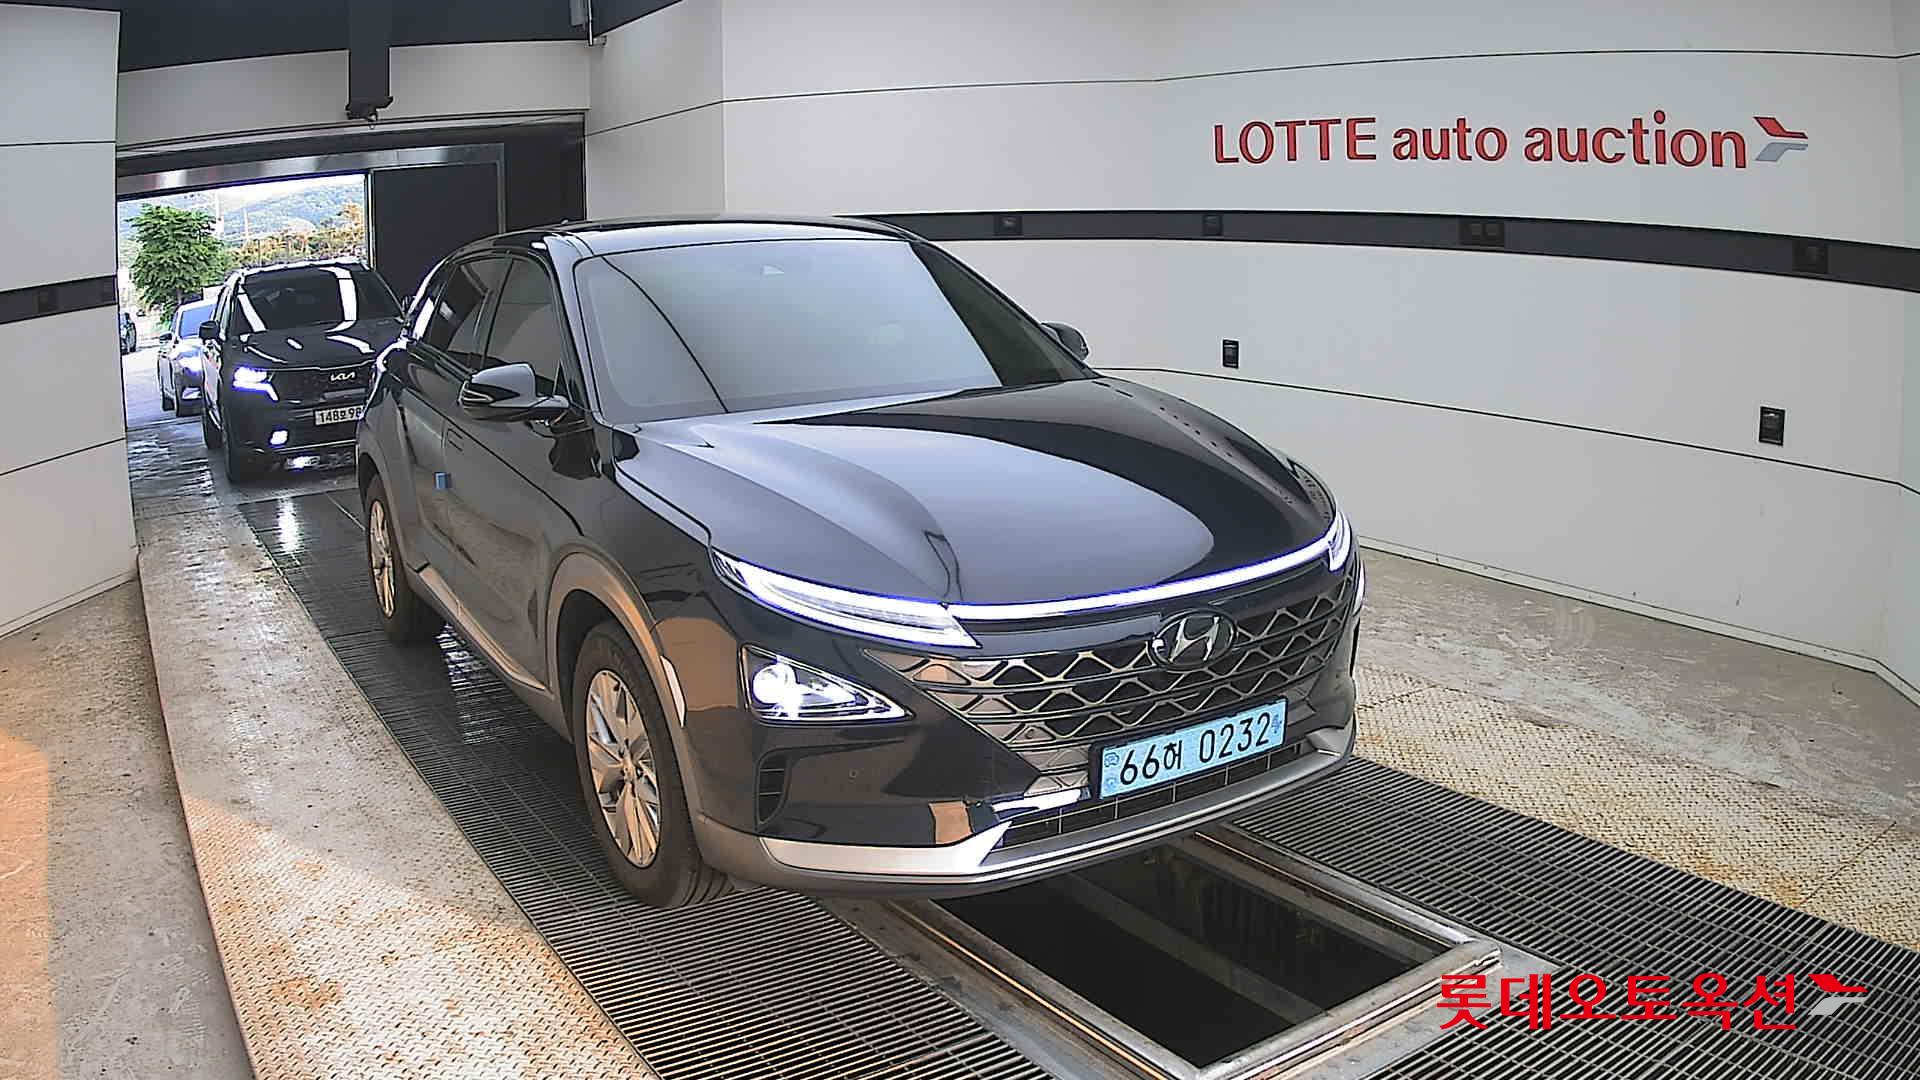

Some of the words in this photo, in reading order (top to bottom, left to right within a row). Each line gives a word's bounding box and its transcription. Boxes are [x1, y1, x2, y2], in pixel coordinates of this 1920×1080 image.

[1214, 117, 1378, 164] LOTTE
[1392, 117, 1508, 163] auto
[1523, 110, 1748, 169] auction
[1120, 739, 1183, 785] 66허
[1199, 711, 1271, 763] 0232
